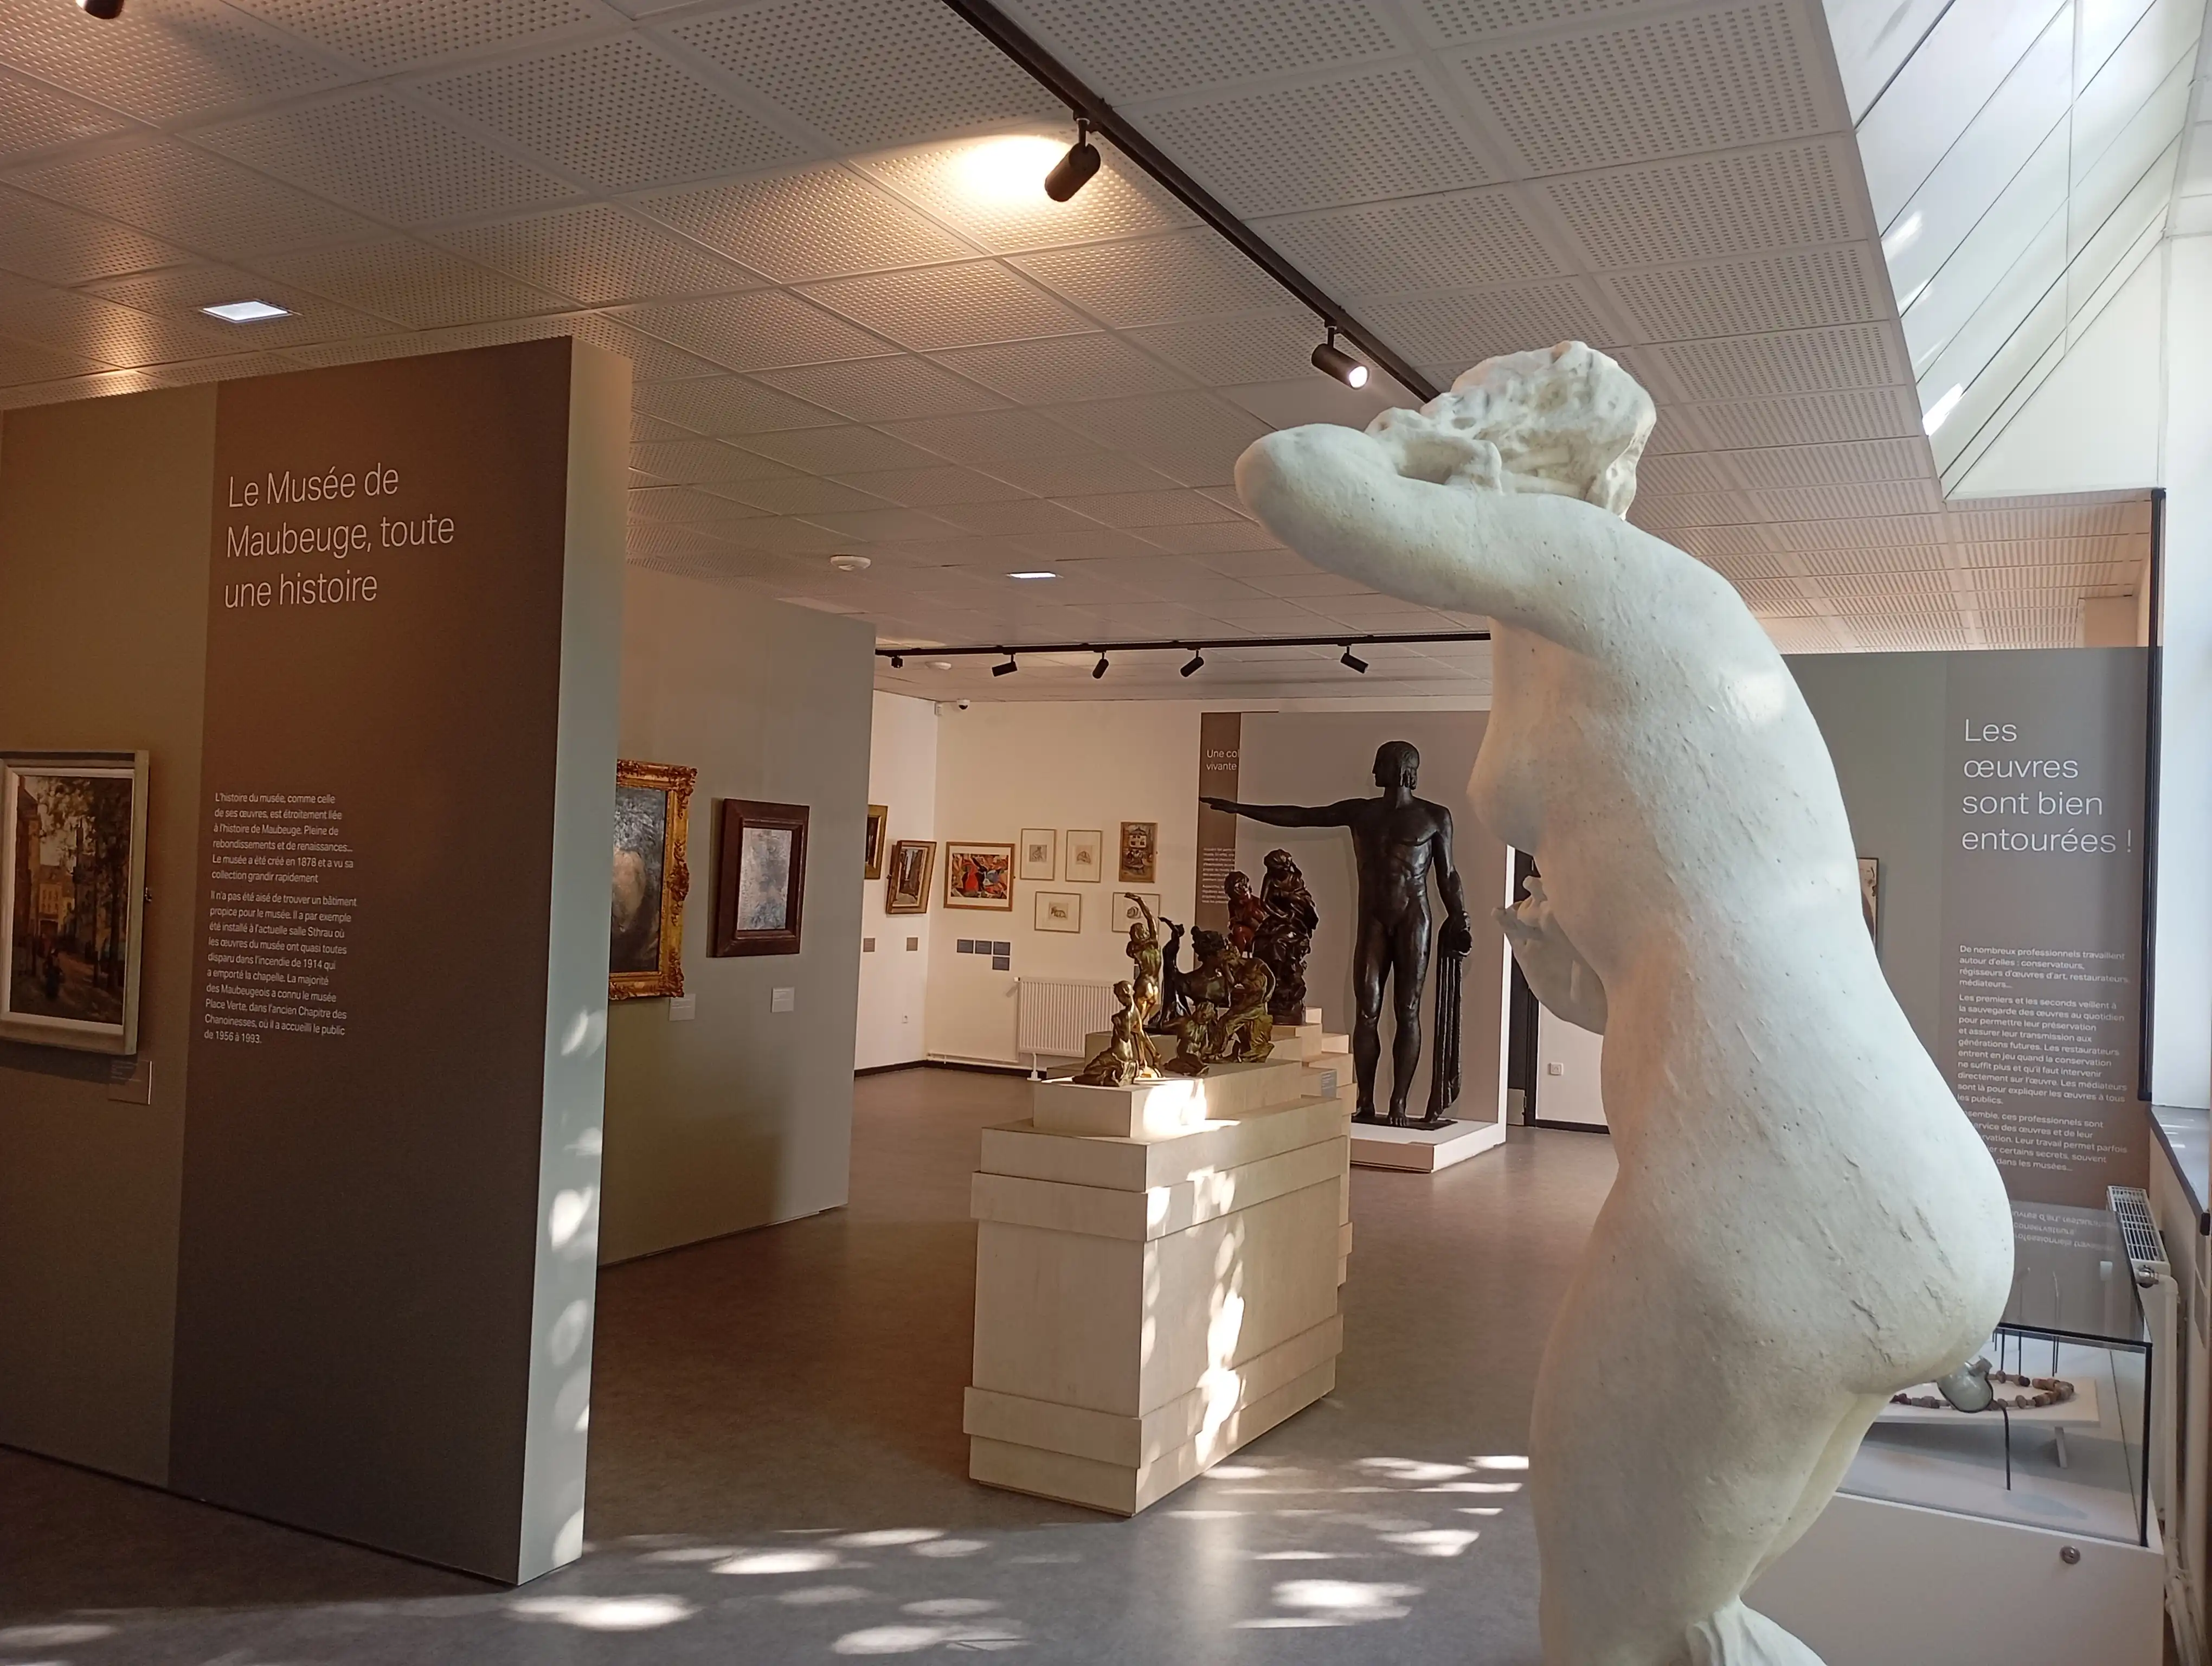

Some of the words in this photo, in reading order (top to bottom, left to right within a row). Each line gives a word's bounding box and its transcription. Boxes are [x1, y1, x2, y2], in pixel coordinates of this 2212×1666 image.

[229, 475, 259, 508] Le
[267, 466, 356, 505] Musée
[364, 463, 399, 497] de
[227, 522, 371, 559] Maubeuge,
[380, 513, 455, 548] toute
[224, 581, 272, 609] une
[279, 569, 377, 606] histoire
[1965, 719, 2017, 742] Les
[1206, 749, 1224, 758] Une
[1206, 761, 1237, 771] vivante
[1963, 759, 2079, 779] œuvres
[215, 793, 248, 801] L'histoire
[317, 794, 336, 802] celle
[1962, 792, 2029, 815] sont
[2038, 791, 2103, 816] bien
[215, 809, 224, 817] de
[220, 824, 249, 833] l'histoire
[251, 825, 260, 833] de
[304, 826, 327, 835] Pleine
[329, 826, 339, 835] de
[213, 840, 275, 849] rebondissements
[286, 842, 296, 850] de
[1962, 828, 2117, 854] entourées
[213, 855, 221, 863] Le
[223, 856, 247, 864] musée
[254, 856, 266, 864] été
[267, 857, 284, 865] créé
[298, 858, 316, 866] 1878
[216, 892, 226, 900] n'a
[242, 893, 254, 901] été
[255, 893, 271, 901] aisé
[272, 894, 281, 902] de
[323, 896, 357, 905] bâtiment
[210, 908, 237, 917] propice
[319, 913, 352, 923] exemple
[209, 922, 221, 931] été
[289, 927, 306, 936] salle
[208, 938, 219, 946] les
[260, 941, 285, 950] musée
[300, 944, 321, 953] quasi
[323, 945, 347, 953] toutes
[2017, 948, 2081, 957] professionnels
[208, 953, 235, 964] disparu
[236, 955, 254, 964] dans
[255, 956, 290, 966] l'incendie
[304, 959, 322, 968] 1914
[324, 961, 337, 970] qui
[213, 970, 243, 979] emporté
[1959, 969, 2003, 977] régisseurs
[2005, 970, 2044, 978] d'œuvres
[207, 984, 220, 993] des
[221, 985, 270, 997] Maubeugeois
[311, 994, 337, 1002] musée
[205, 999, 226, 1009] Place
[249, 1003, 267, 1013] dans
[268, 1005, 297, 1015] l'ancien
[298, 1007, 331, 1018] Chapitre
[332, 1010, 348, 1019] des
[321, 1025, 345, 1034] public
[2042, 1021, 2097, 1030] préservation
[216, 1031, 233, 1041] 1956
[242, 1034, 262, 1043] 1993.
[2020, 1032, 2075, 1041] transmission
[1958, 1039, 2008, 1048] générations
[2010, 1042, 2042, 1050] futures.
[2061, 1046, 2120, 1054] restaurateurs
[2002, 1052, 2015, 1060] jeu
[2055, 1058, 2112, 1066] conservation
[2061, 1067, 2102, 1076] intervenir
[1958, 1072, 2008, 1082] directement
[2078, 1081, 2127, 1090] médiateurs
[2008, 1087, 2048, 1096] expliquer
[2018, 1114, 2082, 1125] professionnels
[2076, 1130, 2093, 1138] leur
[1996, 1158, 2017, 1166] dans
